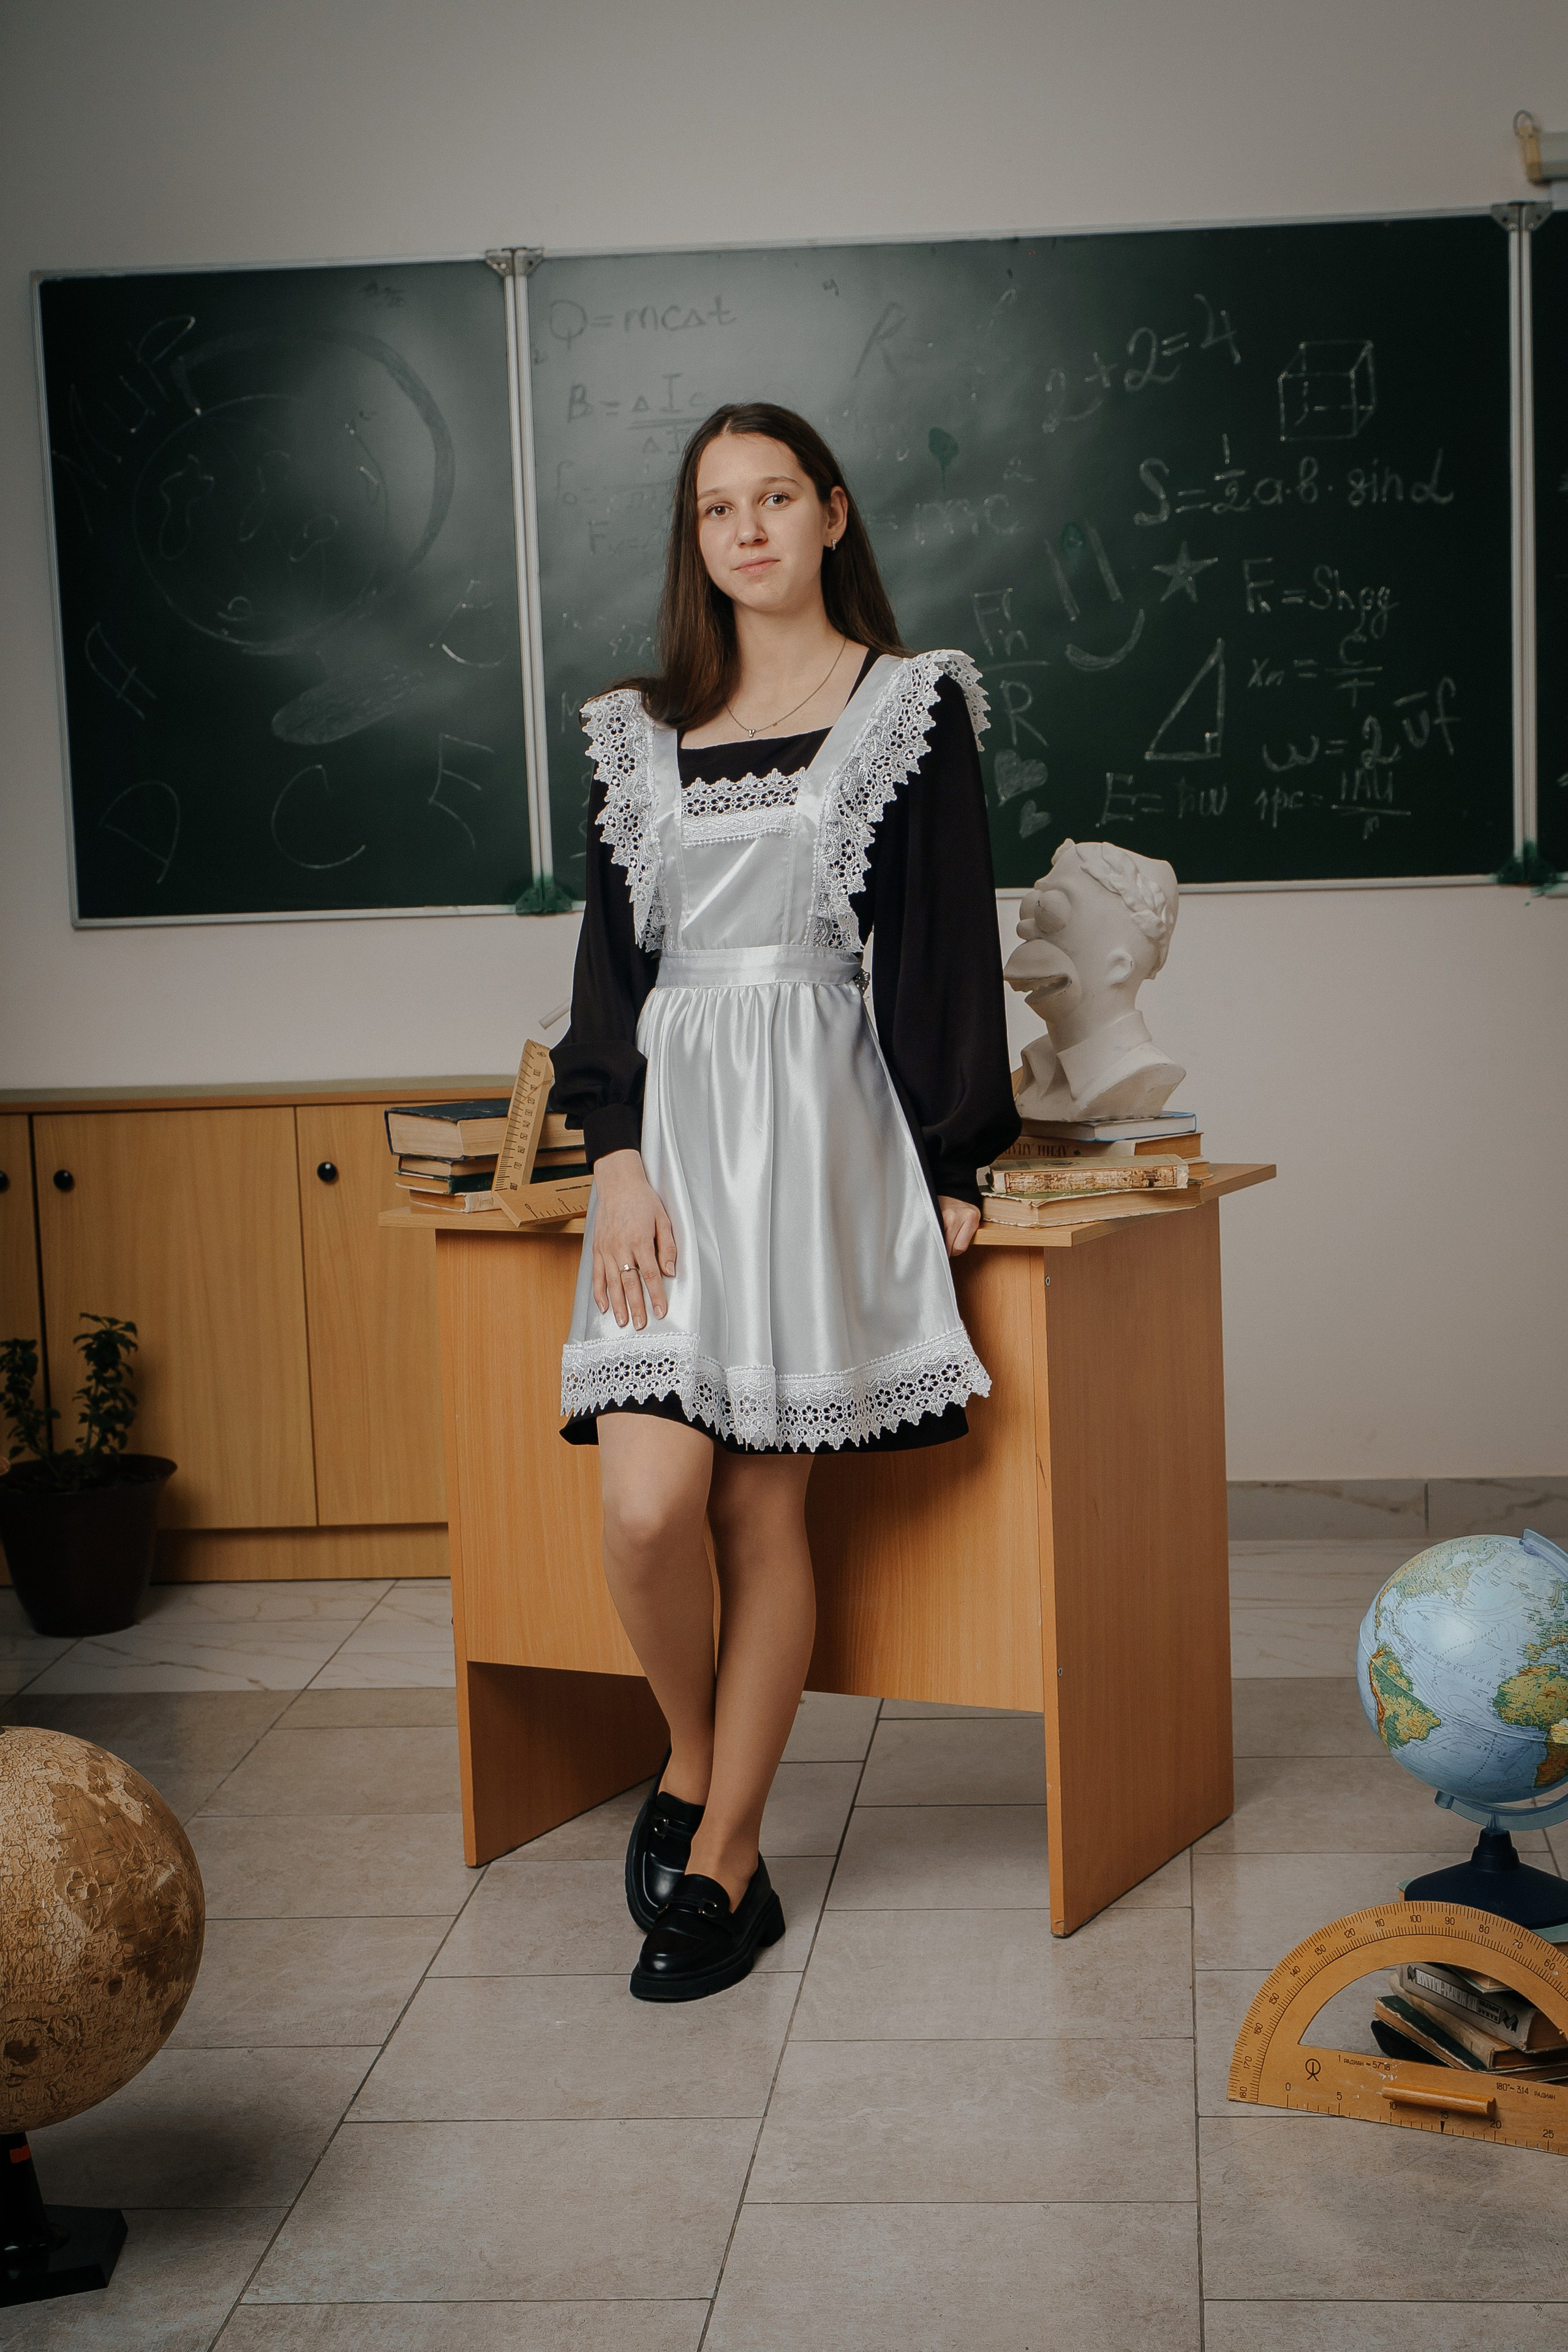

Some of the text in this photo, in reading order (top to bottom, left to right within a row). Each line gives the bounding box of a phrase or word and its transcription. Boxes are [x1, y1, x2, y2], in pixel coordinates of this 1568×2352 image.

[1374, 1918, 1385, 1928] 110
[1410, 1914, 1422, 1923] 100
[1444, 1916, 1455, 1926] 90
[1344, 1928, 1356, 1939] 120
[1479, 1924, 1490, 1934] 80
[1314, 1944, 1327, 1956] 130
[1512, 1939, 1523, 1950] 70
[1544, 1959, 1556, 1970] 60
[1289, 1965, 1302, 1978] 140
[1268, 1992, 1280, 2005] 150
[1253, 2022, 1264, 2035] 160
[1243, 2056, 1253, 2070] 170
[1343, 2058, 1364, 2067] РАДИАН
[1239, 2086, 1248, 2098] 180
[1534, 2090, 1556, 2100] РАДИАН
[1285, 2082, 1555, 2139] 0 5 10 15 20 25
